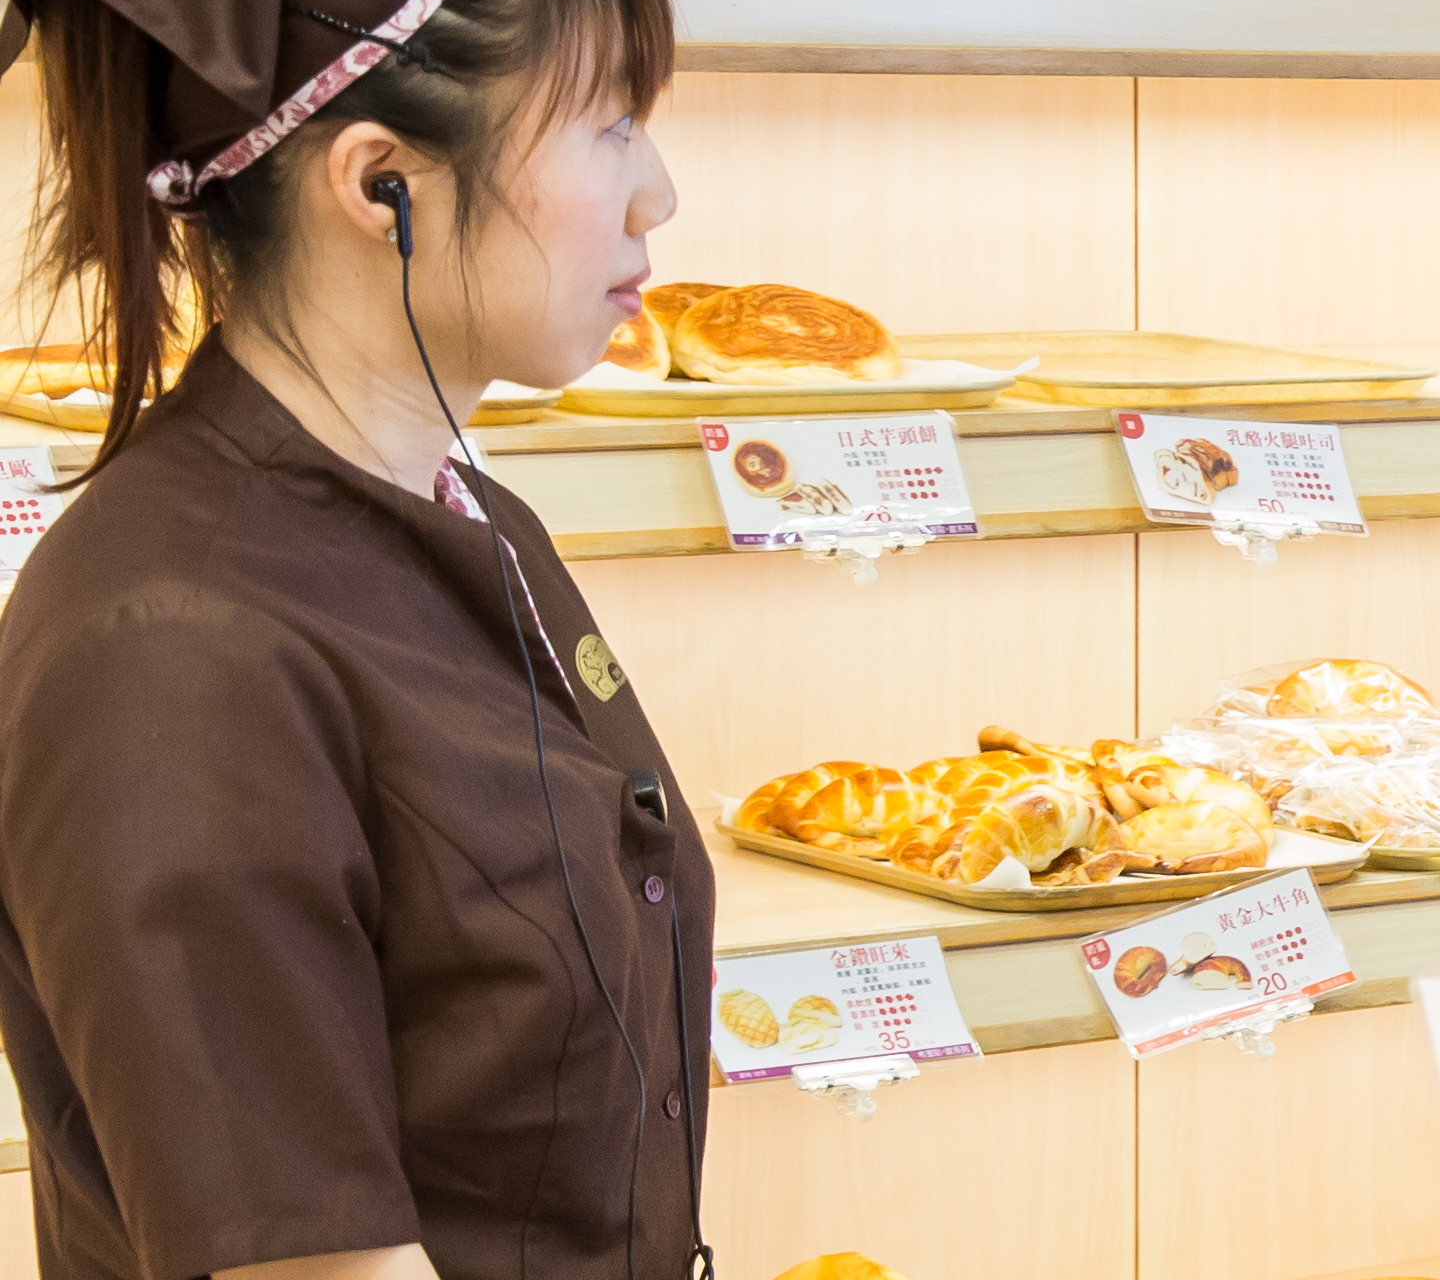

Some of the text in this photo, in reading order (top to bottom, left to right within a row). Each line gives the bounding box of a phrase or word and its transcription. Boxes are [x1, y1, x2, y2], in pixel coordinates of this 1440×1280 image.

[836, 424, 939, 448] 日式芋頭餅
[1226, 428, 1335, 452] 乳酪火腿吐司
[1258, 498, 1286, 514] 50
[1216, 887, 1312, 933] 黃金大牛角
[830, 942, 912, 969] 金鑽旺來
[1256, 971, 1289, 997] 20
[877, 1029, 912, 1052] 35
